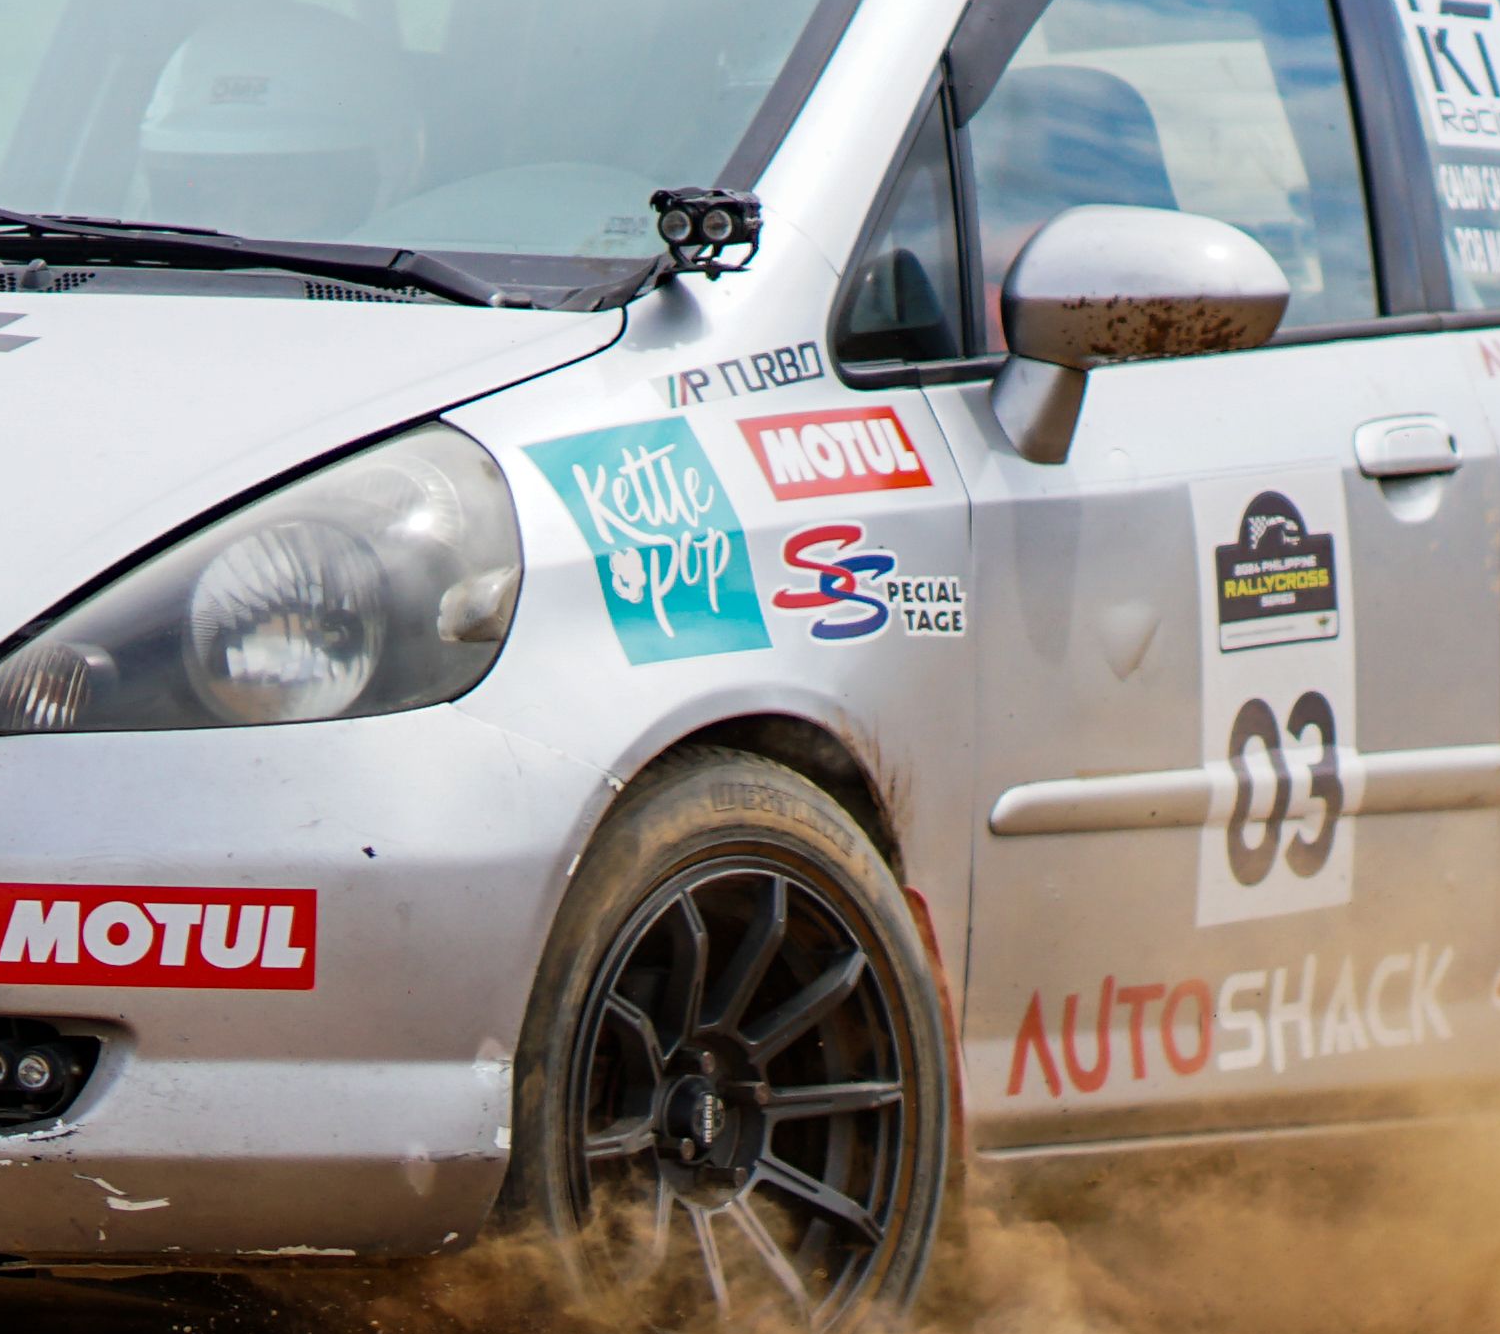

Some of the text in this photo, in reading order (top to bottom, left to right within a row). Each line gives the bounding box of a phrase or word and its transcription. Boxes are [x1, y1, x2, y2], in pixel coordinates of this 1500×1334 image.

[715, 340, 826, 396] TURBO
[759, 418, 921, 484] MOTUL
[572, 444, 715, 545] Kettle
[1224, 568, 1330, 598] RALLYCROSS
[1226, 690, 1345, 887] 03
